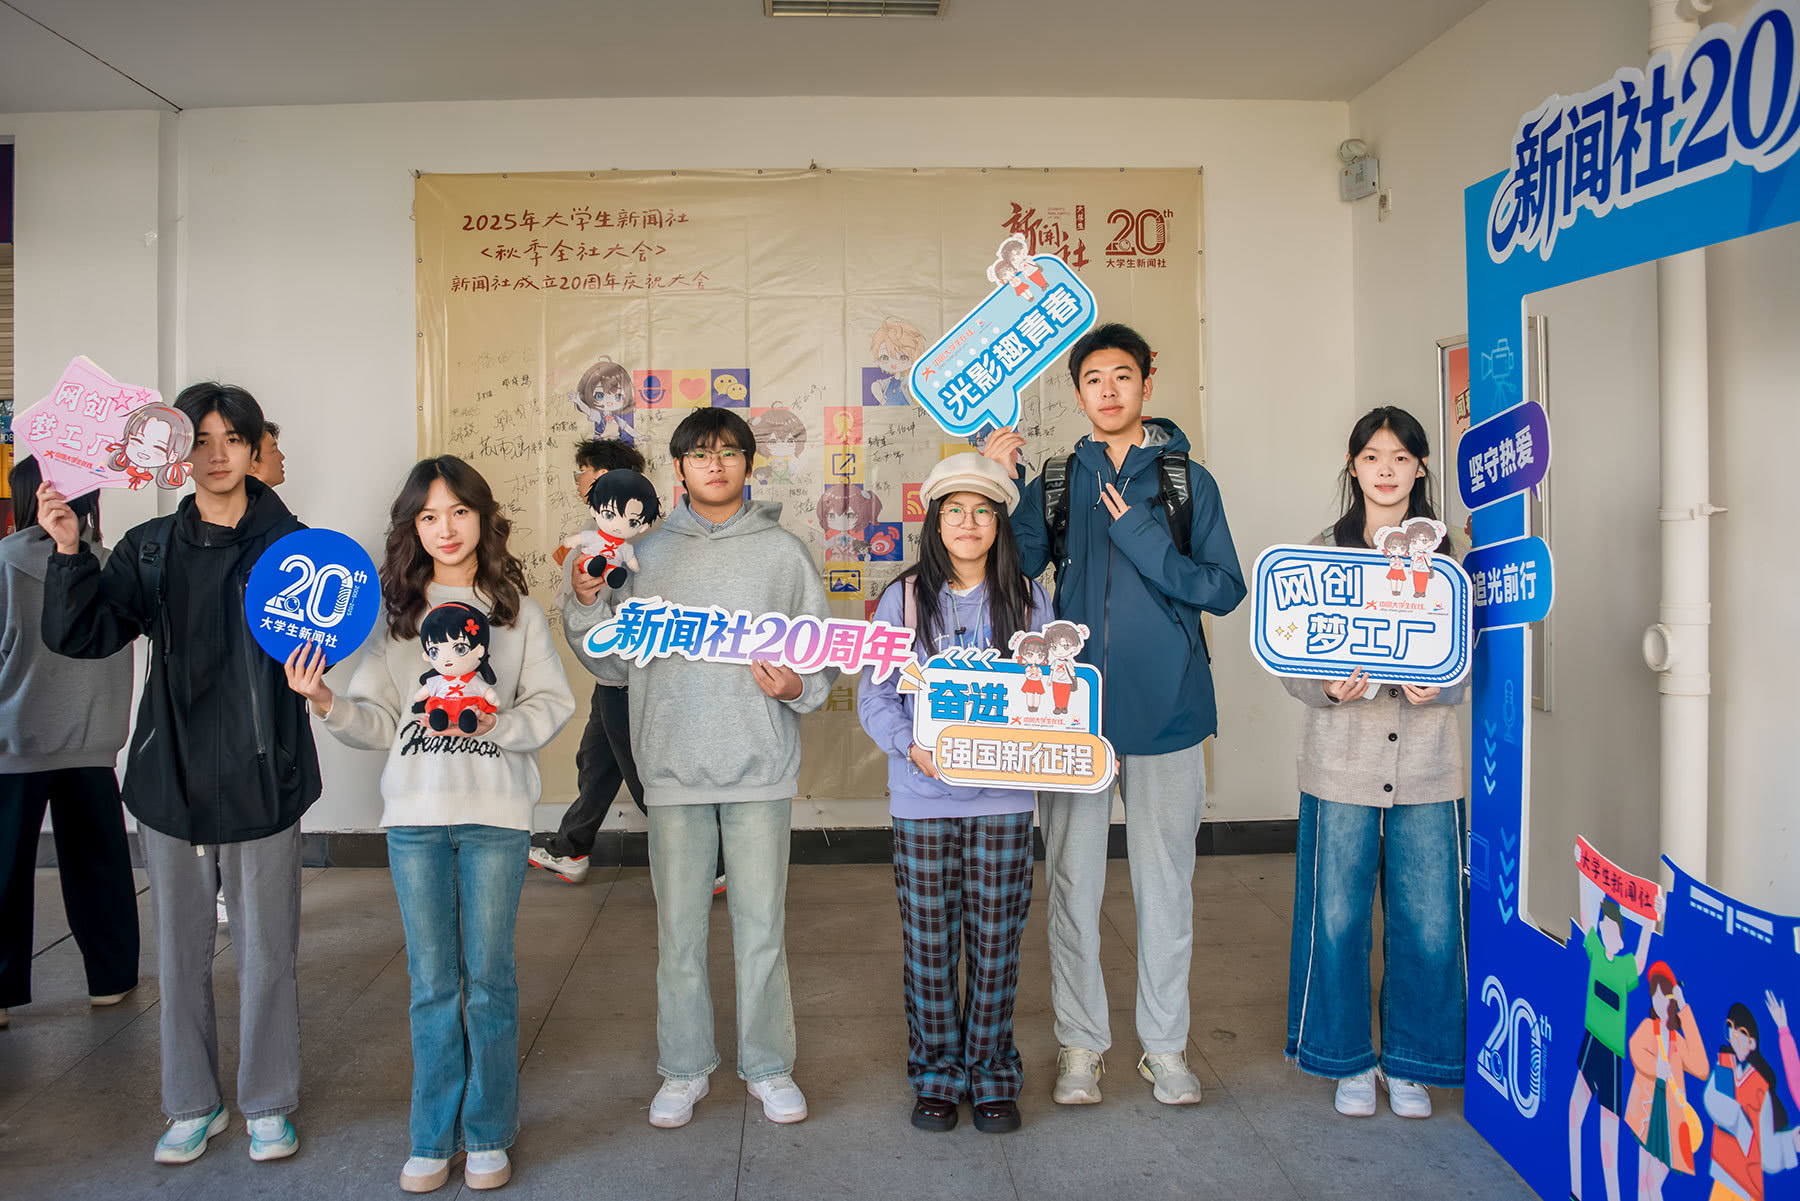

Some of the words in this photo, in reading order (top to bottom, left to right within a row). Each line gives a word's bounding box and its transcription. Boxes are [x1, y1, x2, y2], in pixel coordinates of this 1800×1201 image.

[1492, 8, 1800, 253] 新闻社20
[462, 206, 690, 232] 2025年大学生新闻社
[1105, 209, 1174, 256] 20th
[450, 271, 712, 293] 新闻社成立20周年庆祝大会
[1105, 258, 1168, 269] 大学生新闻社
[940, 284, 1082, 419] 光影趣青春
[55, 381, 113, 423] 网创
[1468, 424, 1535, 494] 坚守热爱
[264, 554, 368, 628] 20th
[1271, 564, 1364, 611] 网创
[1472, 560, 1537, 608] 追光前行
[260, 616, 338, 648] 大学生新闻社
[587, 601, 914, 680] 新闻社20周年
[1306, 612, 1436, 661] 梦工厂
[928, 680, 1009, 725] 奋进
[940, 736, 1095, 778] 强国新征程
[1582, 850, 1653, 909] 大学生新闻社
[1477, 975, 1553, 1120] 20th
